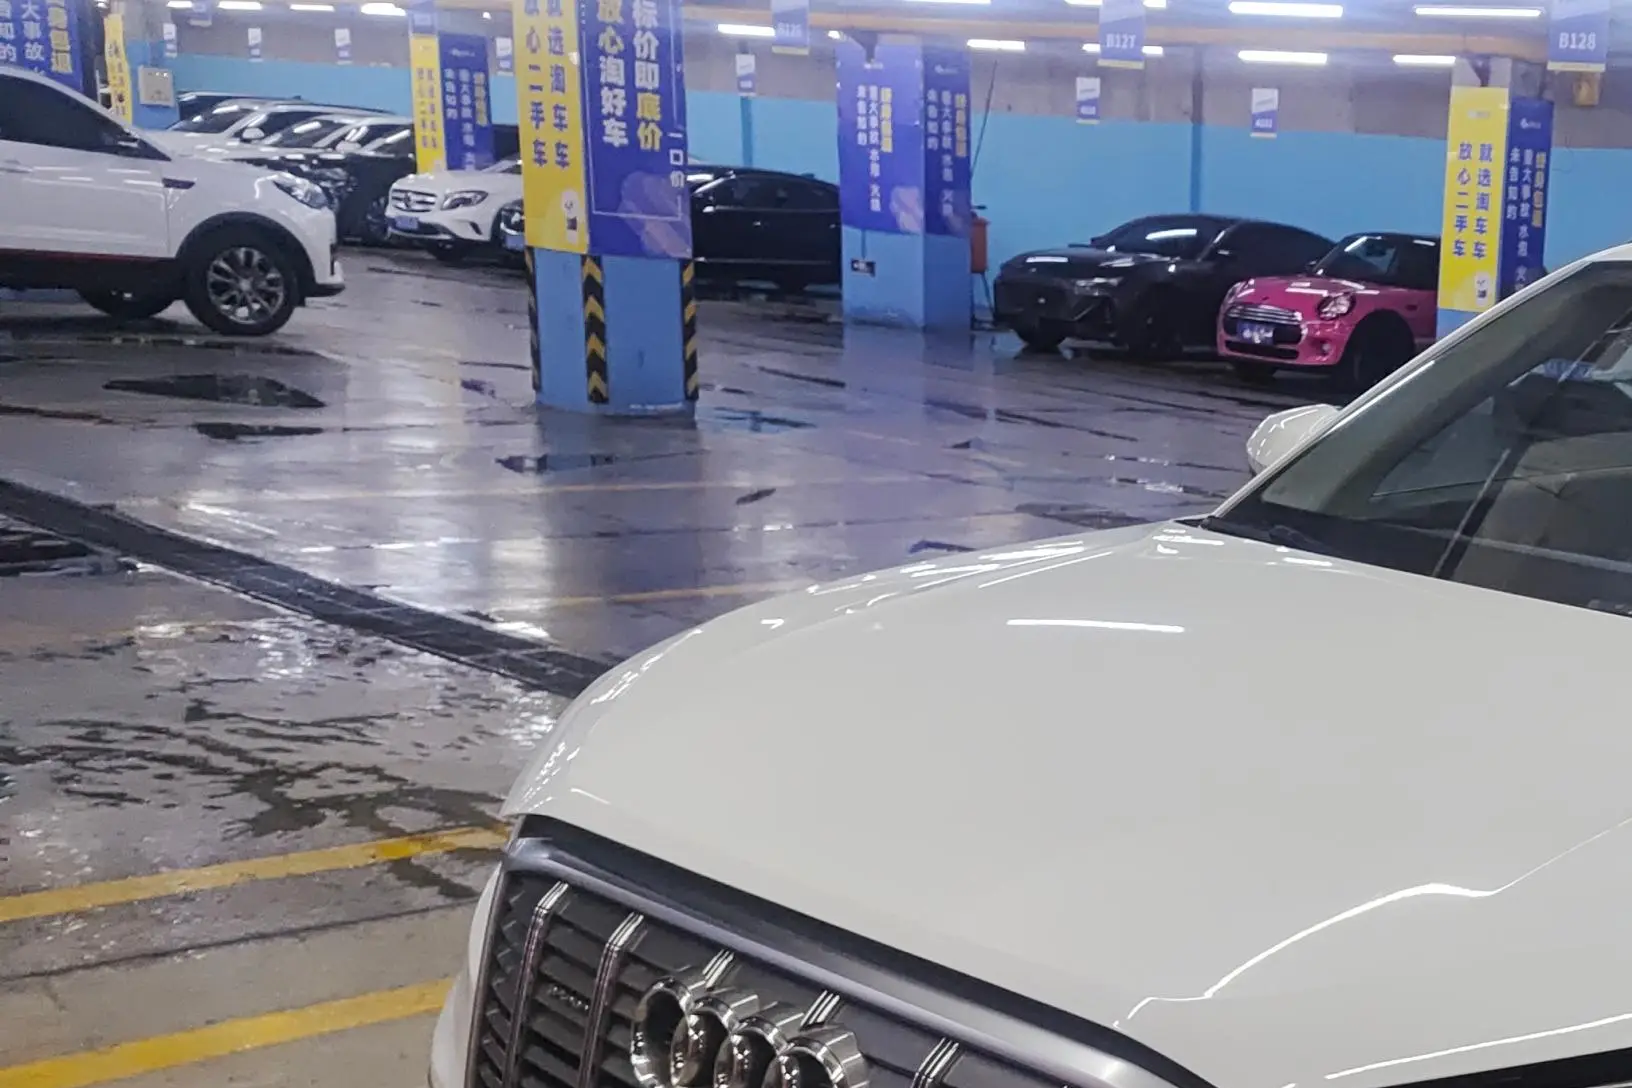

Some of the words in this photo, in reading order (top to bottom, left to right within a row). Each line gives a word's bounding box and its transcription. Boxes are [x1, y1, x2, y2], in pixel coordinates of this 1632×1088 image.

[1558, 32, 1596, 50] B128
[667, 132, 685, 188] 一口价
[1452, 142, 1473, 258] 放心二手车
[1472, 143, 1493, 259] 就选淘车车
